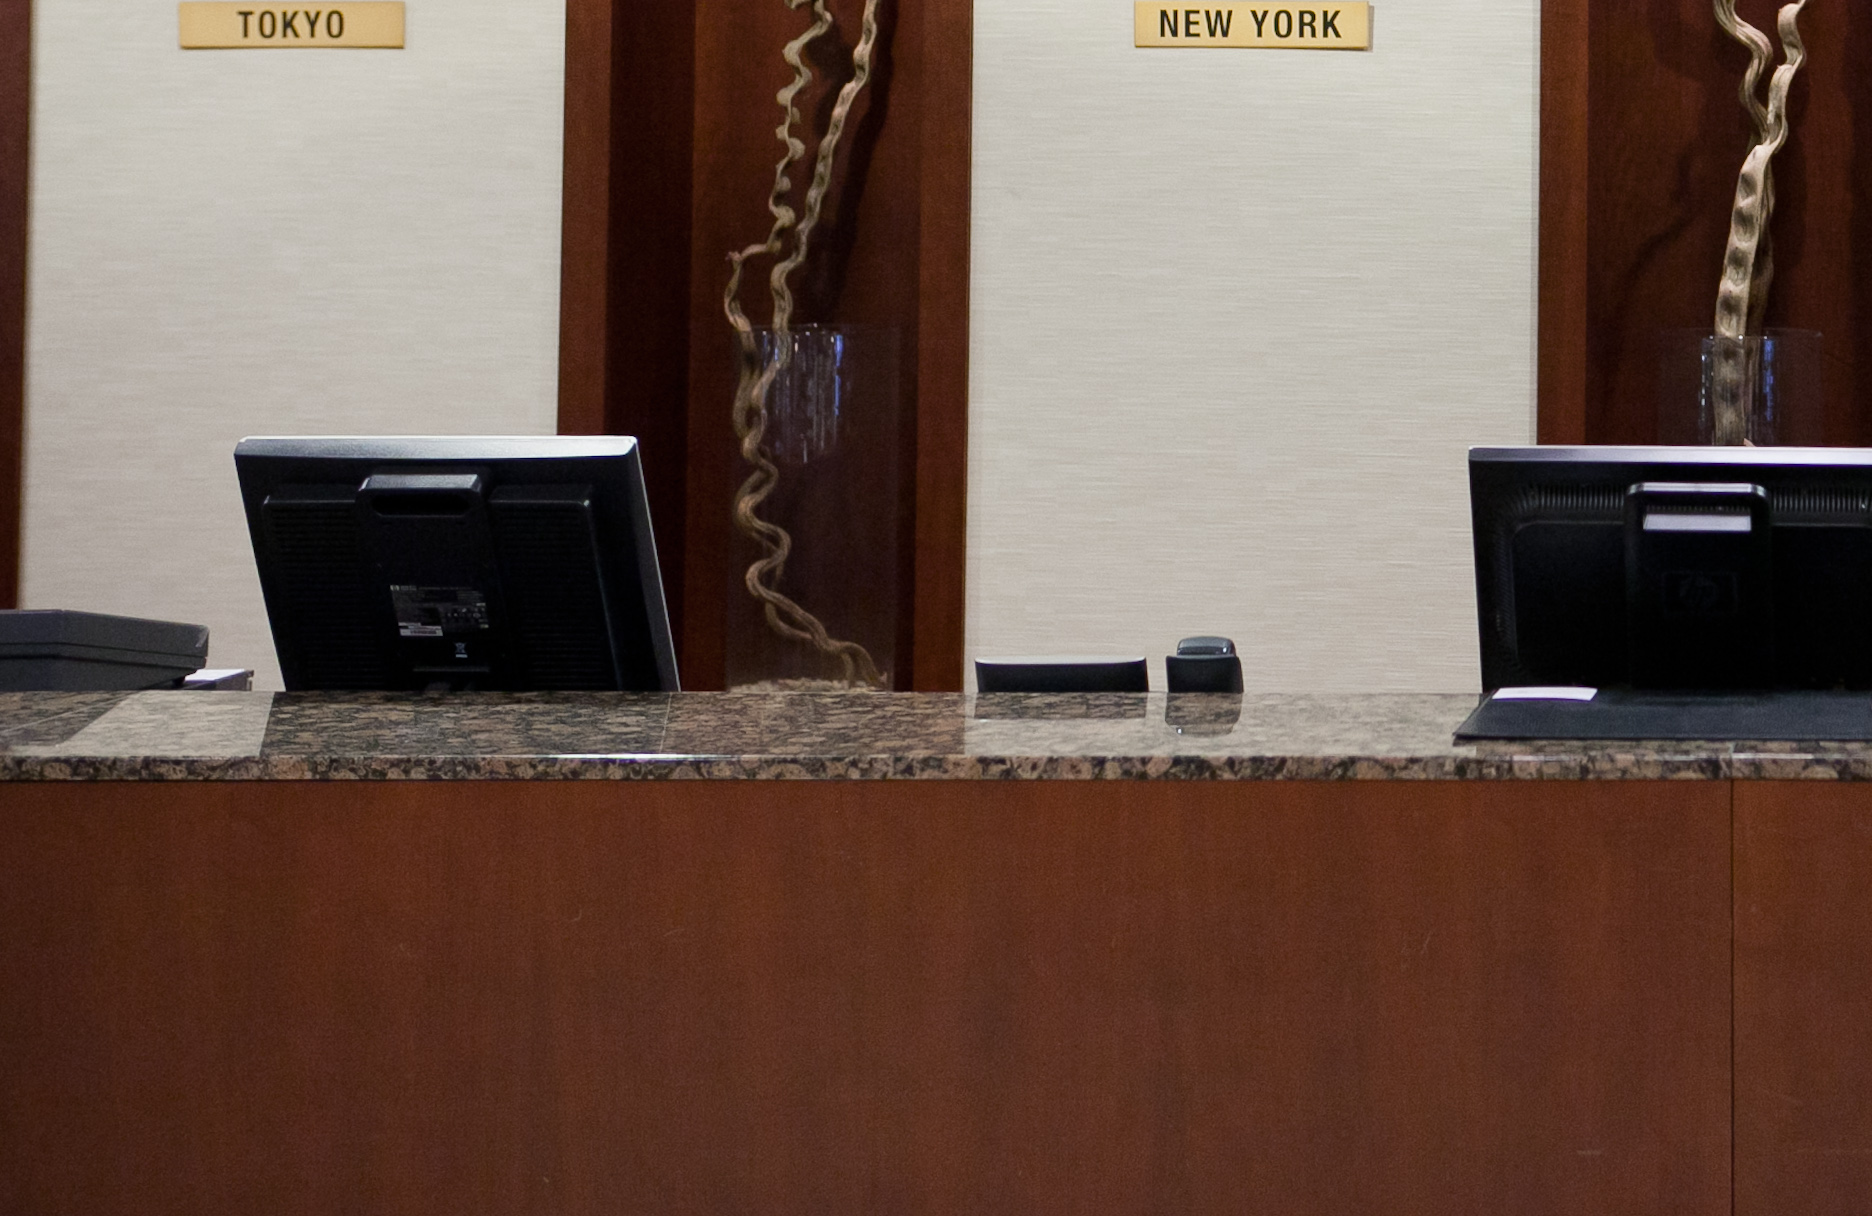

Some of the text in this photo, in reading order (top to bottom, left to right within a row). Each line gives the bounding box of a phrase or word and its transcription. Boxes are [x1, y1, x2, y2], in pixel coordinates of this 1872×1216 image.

[237, 10, 344, 39] TOKYO
[1160, 9, 1342, 39] NEW YORK
